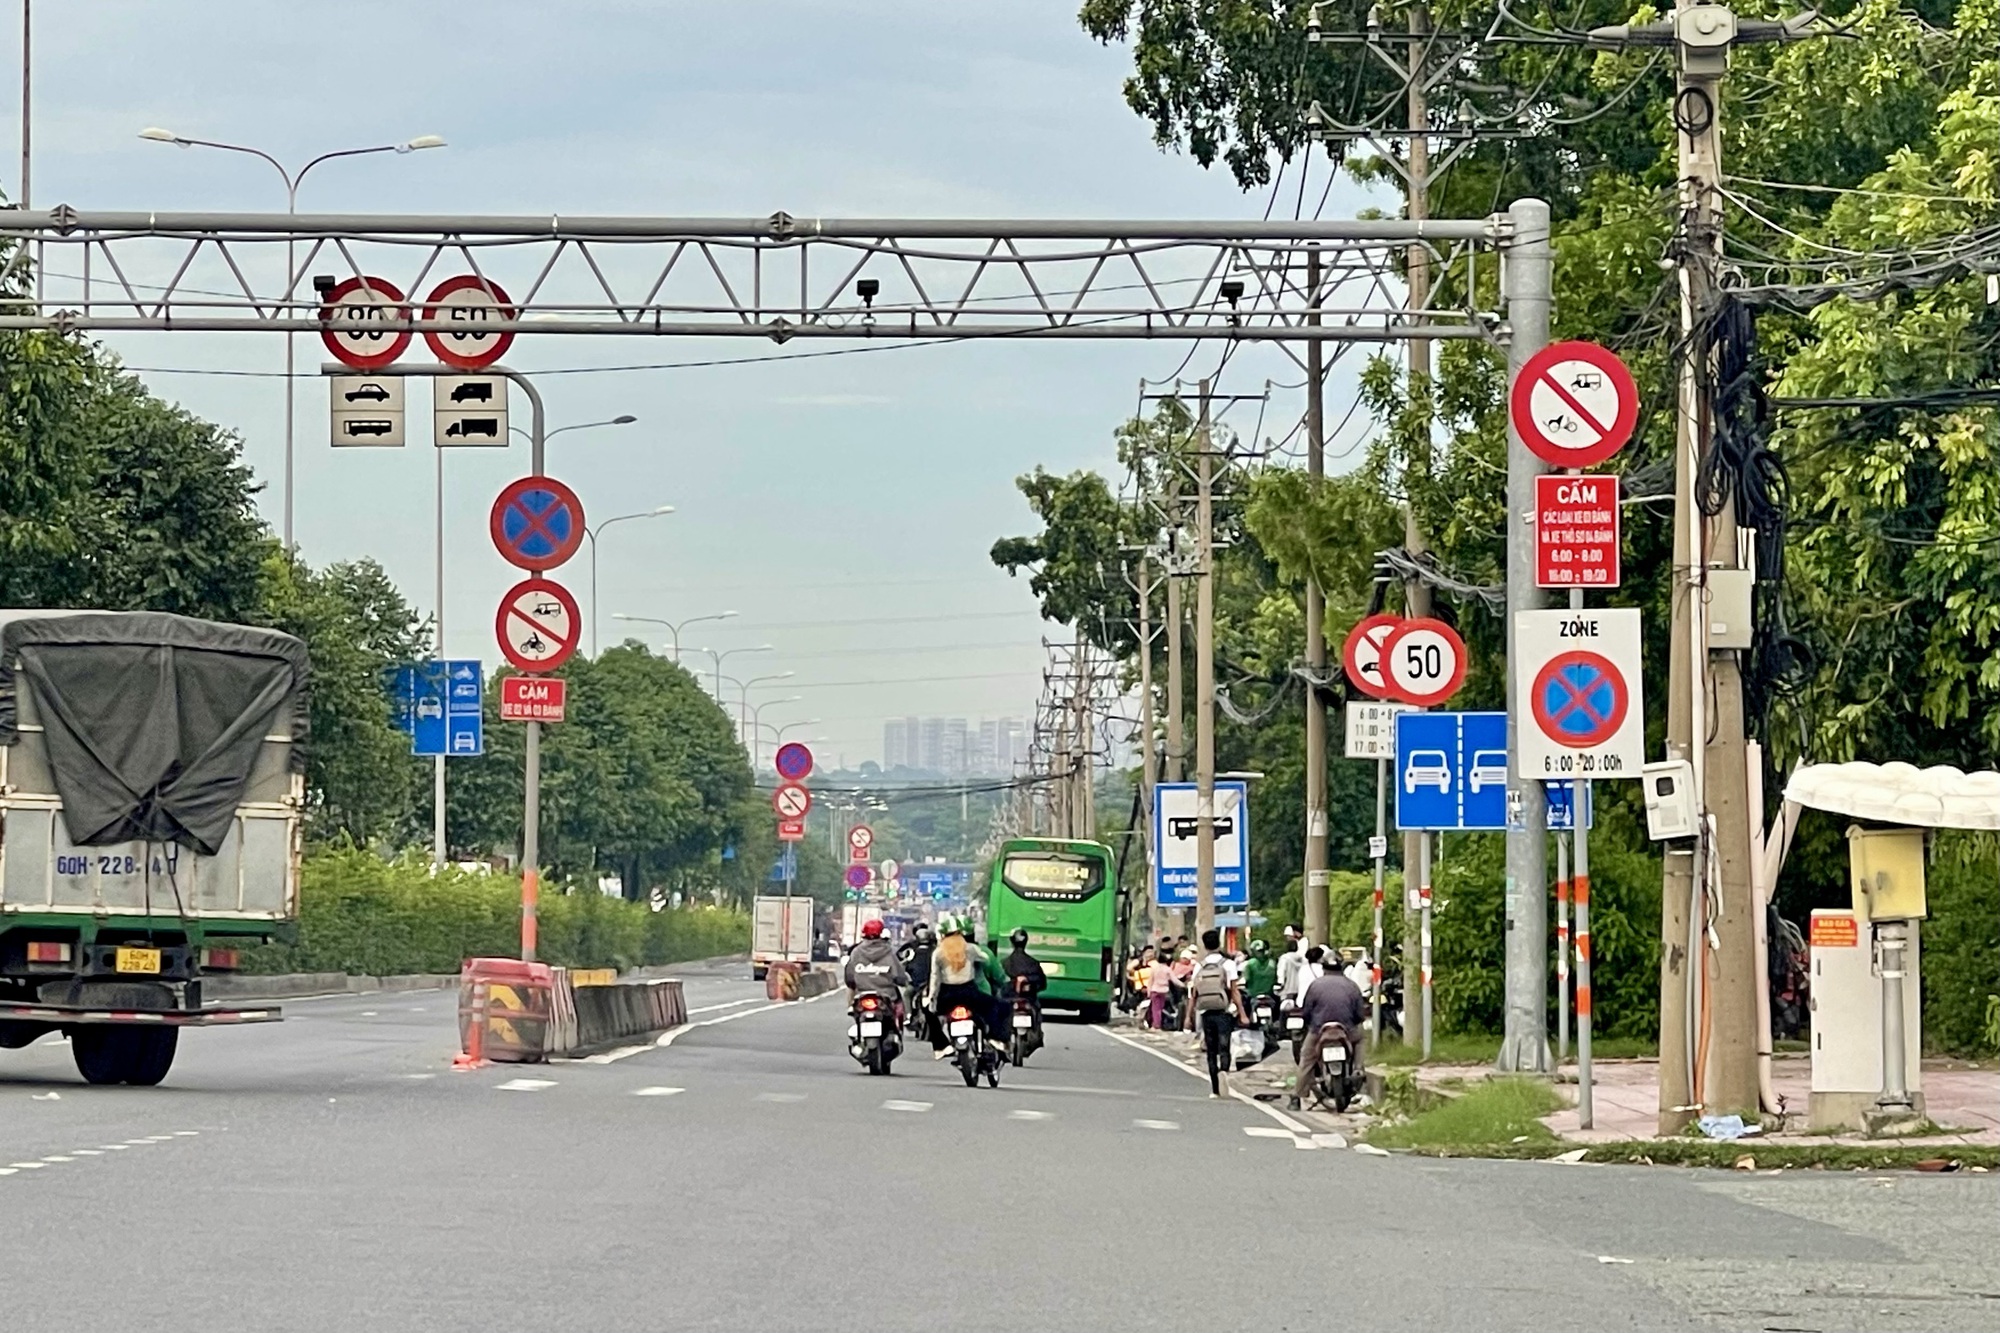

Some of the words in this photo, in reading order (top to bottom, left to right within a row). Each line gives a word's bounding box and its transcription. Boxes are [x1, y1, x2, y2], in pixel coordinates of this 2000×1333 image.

[1557, 479, 1597, 504] CẤM
[1560, 621, 1599, 637] ZONE
[1407, 644, 1441, 679] 50
[519, 681, 548, 700] CẤM
